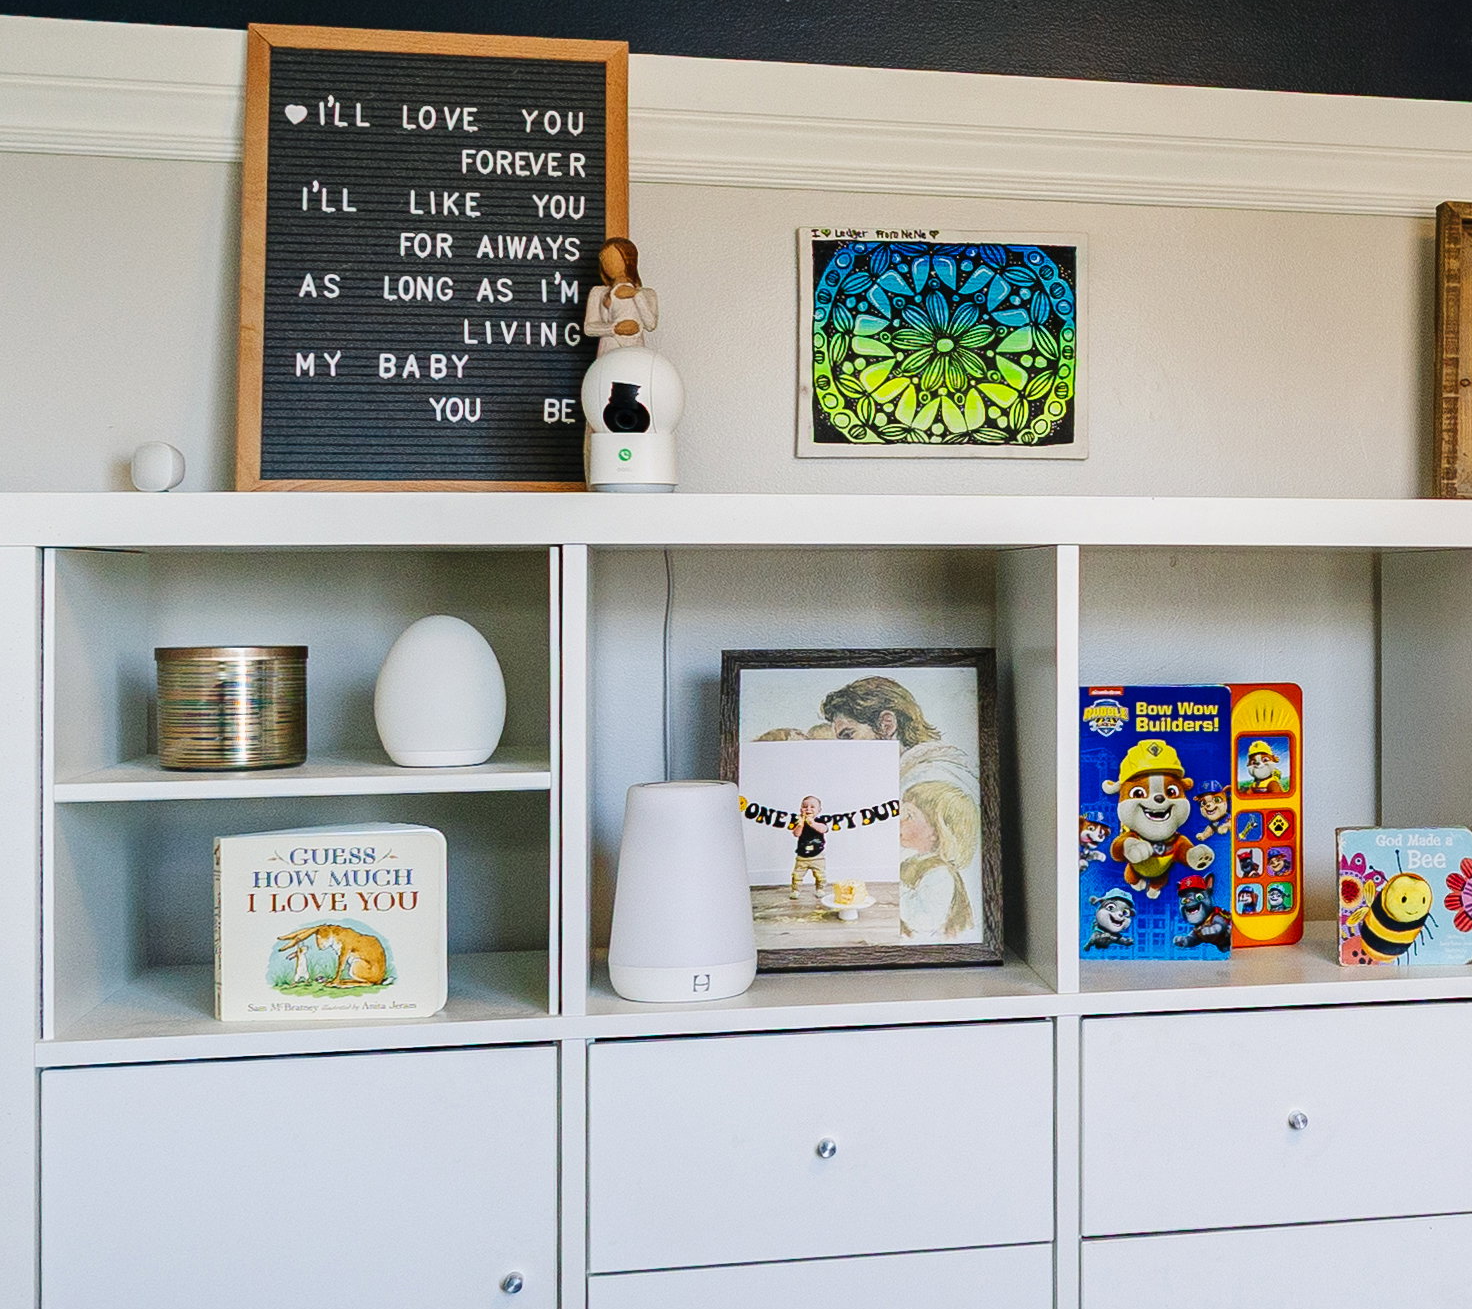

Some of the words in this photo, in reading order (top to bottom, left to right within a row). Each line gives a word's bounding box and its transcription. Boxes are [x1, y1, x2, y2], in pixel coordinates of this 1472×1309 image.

[319, 95, 371, 127] I'LL
[403, 105, 478, 132] LOVE
[522, 109, 584, 136] YOU
[462, 149, 586, 177] FOREVER
[302, 180, 357, 213] I'LL
[410, 190, 480, 217] LIKE
[532, 193, 585, 220] YOU
[400, 232, 453, 258] FOR
[299, 274, 341, 299] AS
[383, 276, 454, 302] LONG
[477, 278, 513, 303] AS
[541, 272, 579, 304] I'M
[464, 319, 580, 346] LIVING
[295, 351, 341, 377] MY
[378, 353, 468, 379] BABY
[429, 397, 481, 423] YOU
[544, 398, 576, 424] BE
[1136, 701, 1173, 715] Bow
[1177, 702, 1219, 715] Wow
[1136, 717, 1219, 732] Builders!
[744, 802, 788, 829] ONE
[1376, 834, 1402, 847] God
[1407, 834, 1441, 846] Made
[1445, 836, 1453, 846] a
[289, 847, 377, 866] GUESS
[1407, 849, 1446, 869] Bee
[252, 870, 318, 889] HOW
[327, 868, 413, 888] MUCH
[248, 893, 257, 913] I
[270, 892, 348, 913] LOVE
[356, 890, 420, 912] YOU
